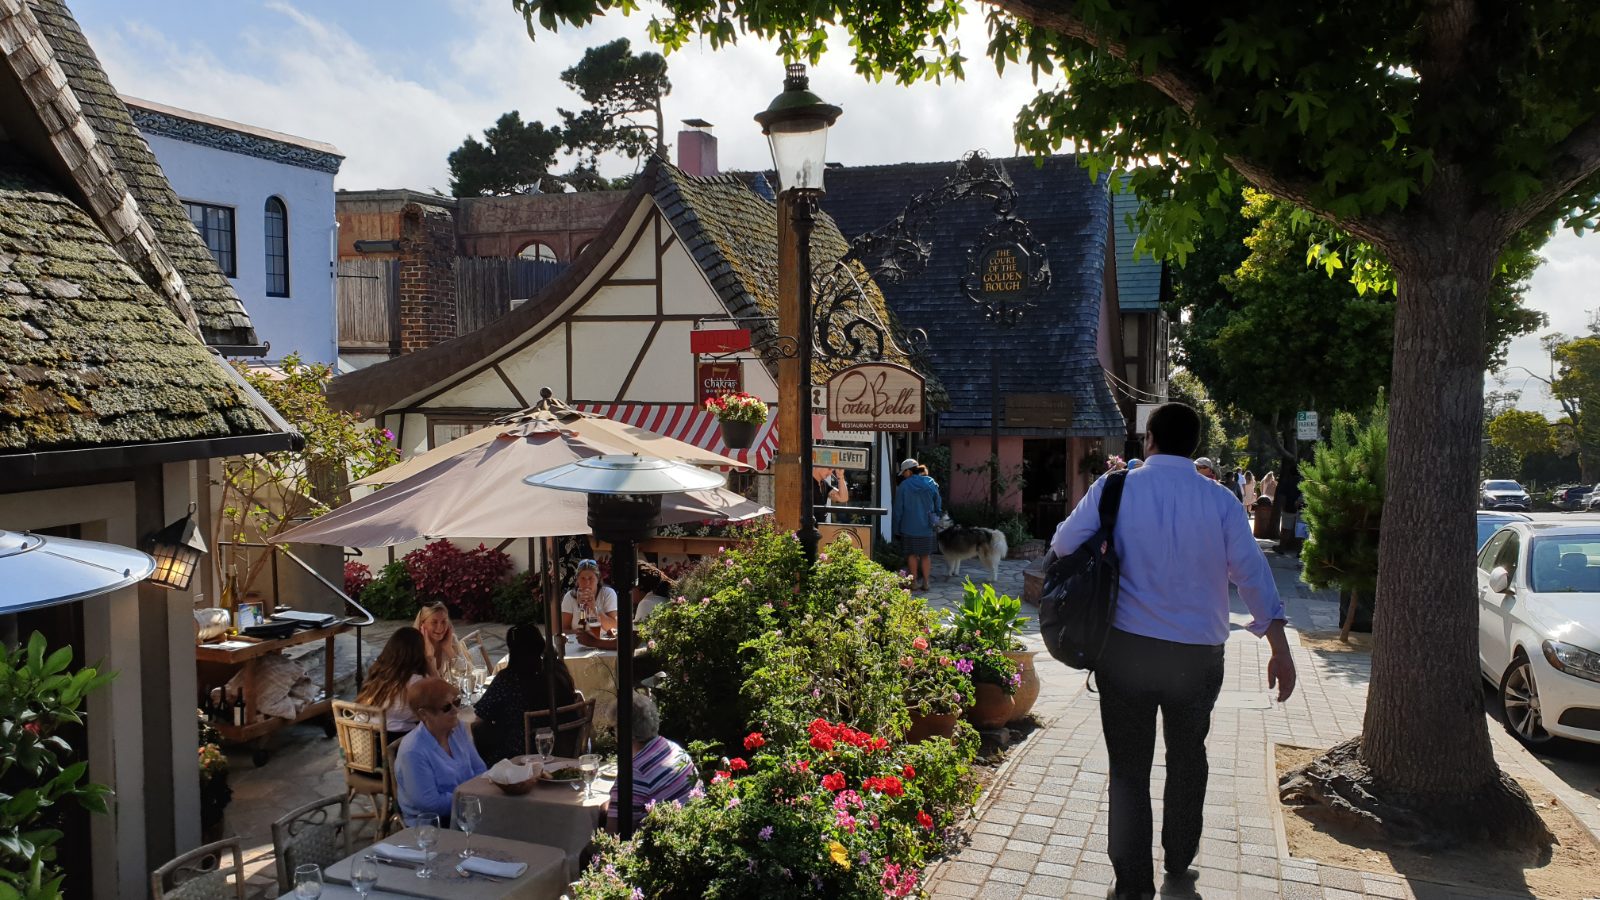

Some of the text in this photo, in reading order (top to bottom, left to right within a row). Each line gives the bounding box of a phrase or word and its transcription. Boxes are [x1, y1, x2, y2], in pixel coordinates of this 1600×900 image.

[996, 249, 1012, 257] THE
[989, 256, 1017, 266] COURT
[983, 272, 1022, 282] GOLDEN
[985, 281, 1020, 292] BOUGH
[704, 377, 737, 389] Chakras
[869, 370, 917, 422] Bella
